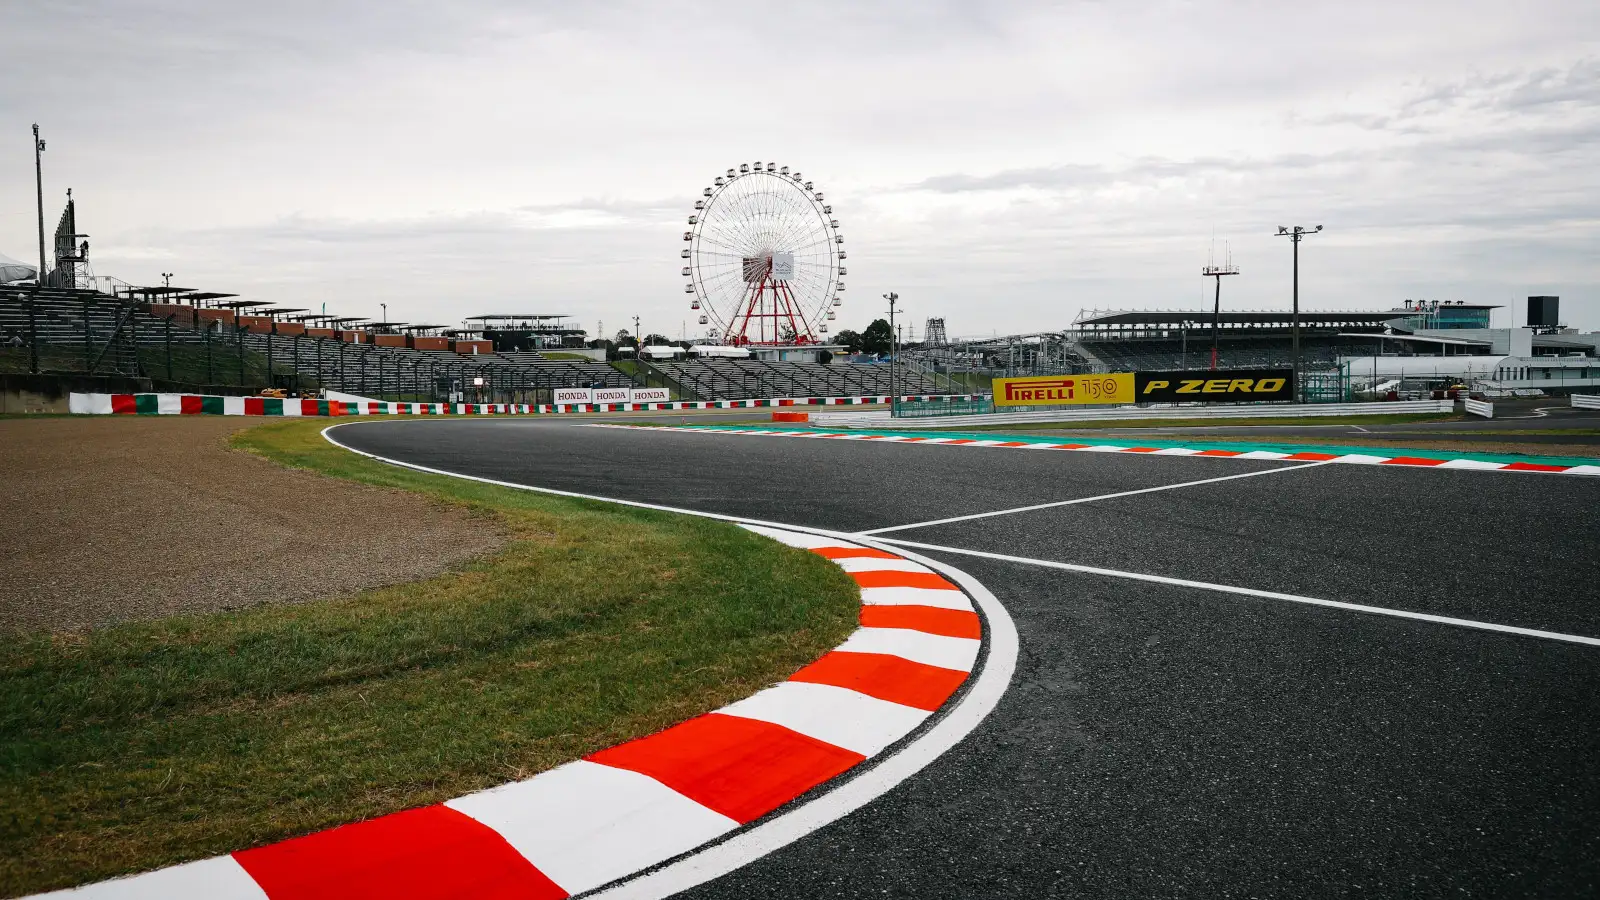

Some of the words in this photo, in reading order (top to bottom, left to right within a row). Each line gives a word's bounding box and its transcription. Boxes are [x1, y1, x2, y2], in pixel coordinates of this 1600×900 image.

[1005, 380, 1074, 400] PIRELLI
[1143, 381, 1169, 394] P
[1175, 378, 1286, 394] ZERO
[558, 392, 588, 400] HONDA
[596, 391, 626, 400] HONDA
[634, 391, 665, 399] HONDA
